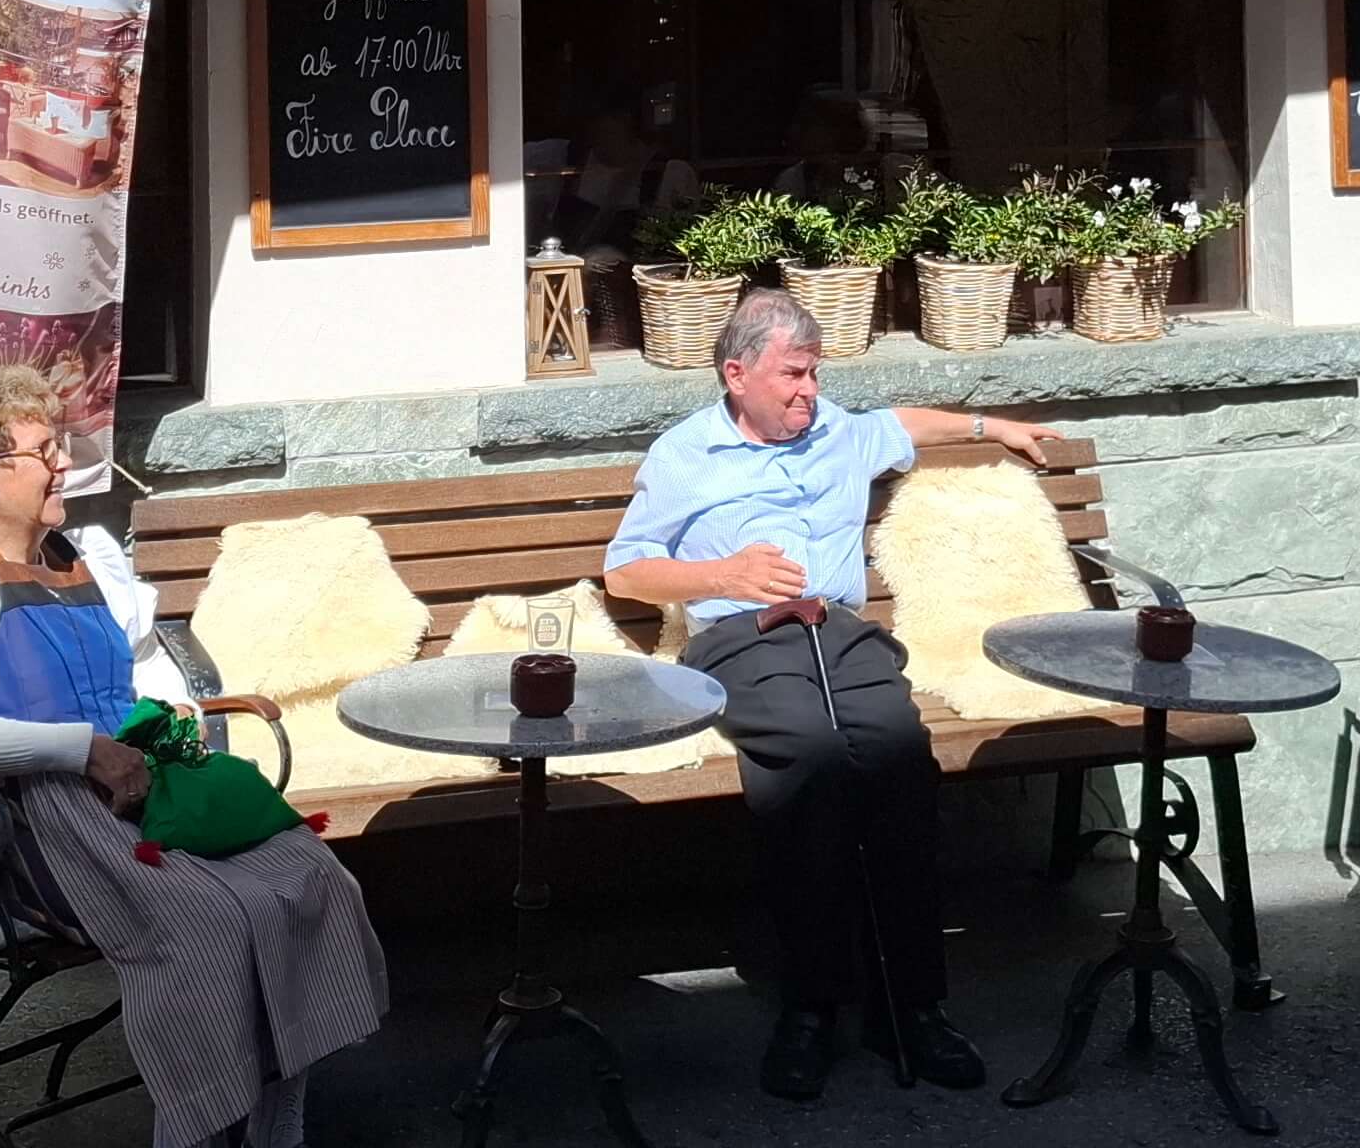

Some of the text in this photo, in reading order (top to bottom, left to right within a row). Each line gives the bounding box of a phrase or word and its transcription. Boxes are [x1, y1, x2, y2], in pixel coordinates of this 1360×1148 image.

[300, 25, 464, 78] ab 17:00 Uhr
[285, 85, 457, 160] Fire Place
[17, 203, 94, 226] geöffnet.
